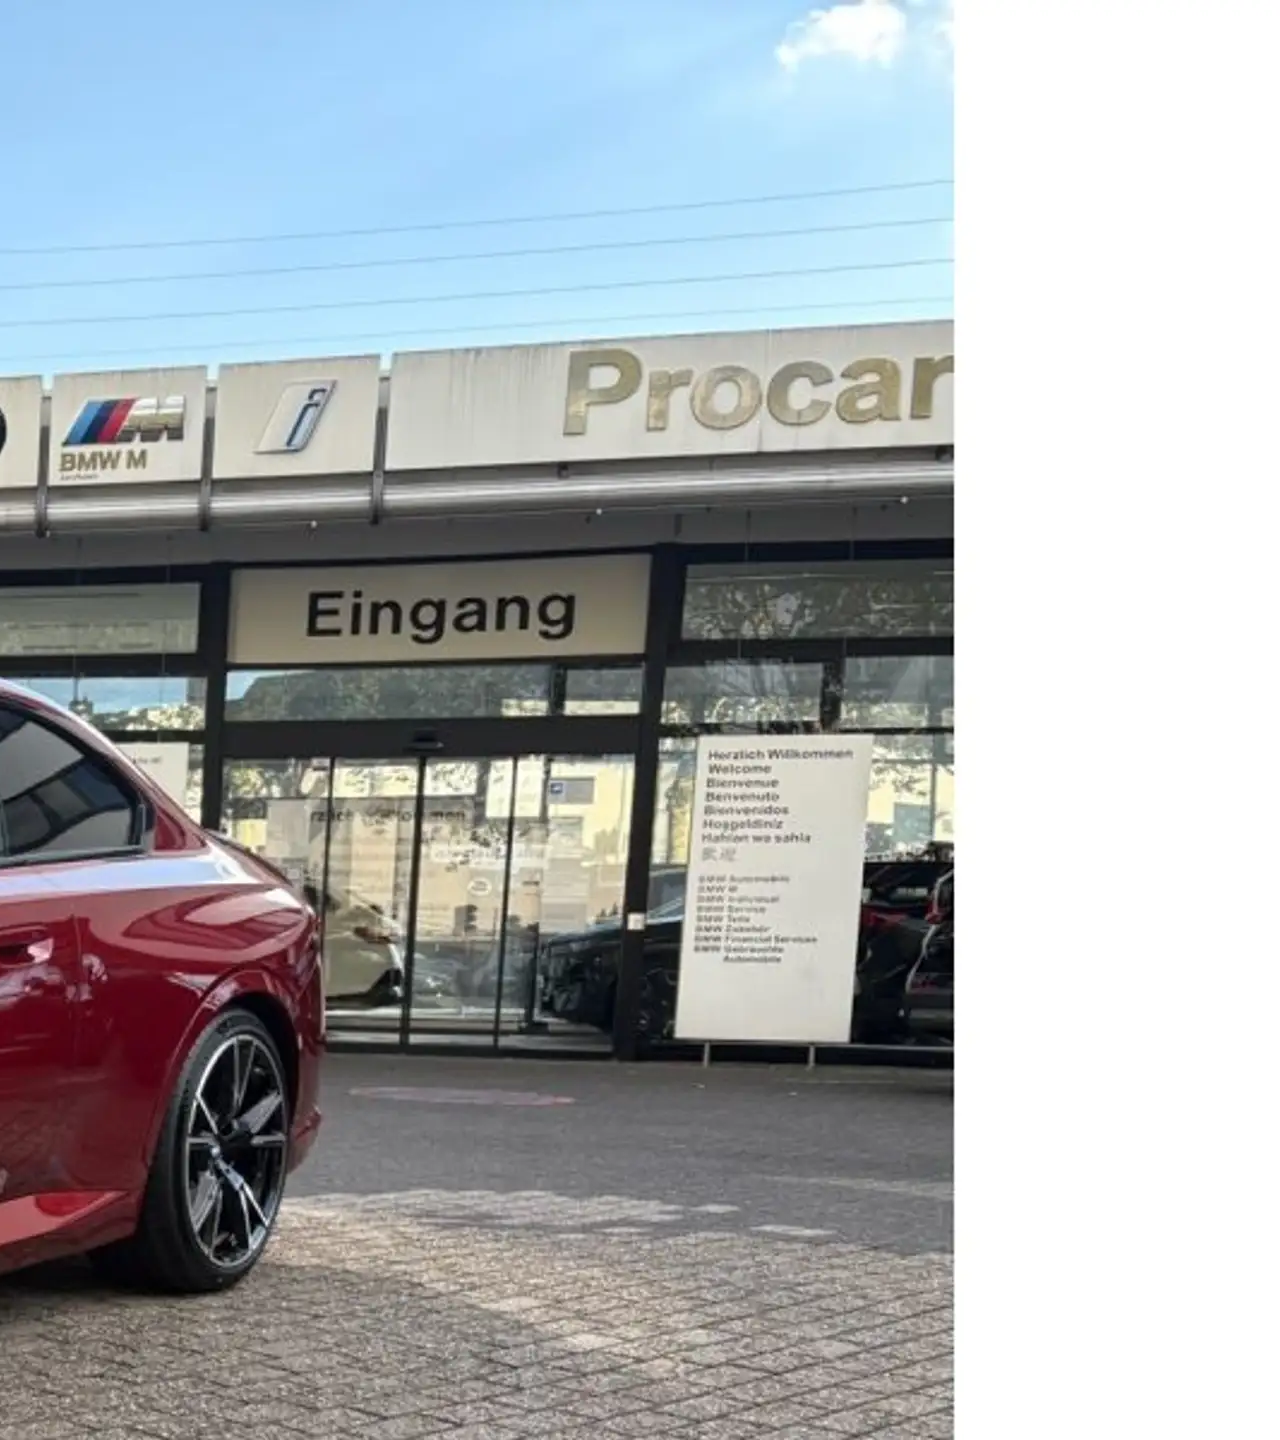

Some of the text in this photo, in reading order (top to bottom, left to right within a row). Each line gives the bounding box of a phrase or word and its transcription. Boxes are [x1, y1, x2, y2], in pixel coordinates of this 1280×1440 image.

[563, 347, 954, 436] Procar
[59, 449, 147, 472] BMW M
[305, 589, 576, 645] Eingang
[708, 748, 854, 761] Herzlich Willkommen
[708, 763, 772, 774] Welcome
[706, 777, 780, 789] Bienvenue
[705, 791, 780, 802] Benvenuto
[704, 804, 790, 816] Bienvenidos
